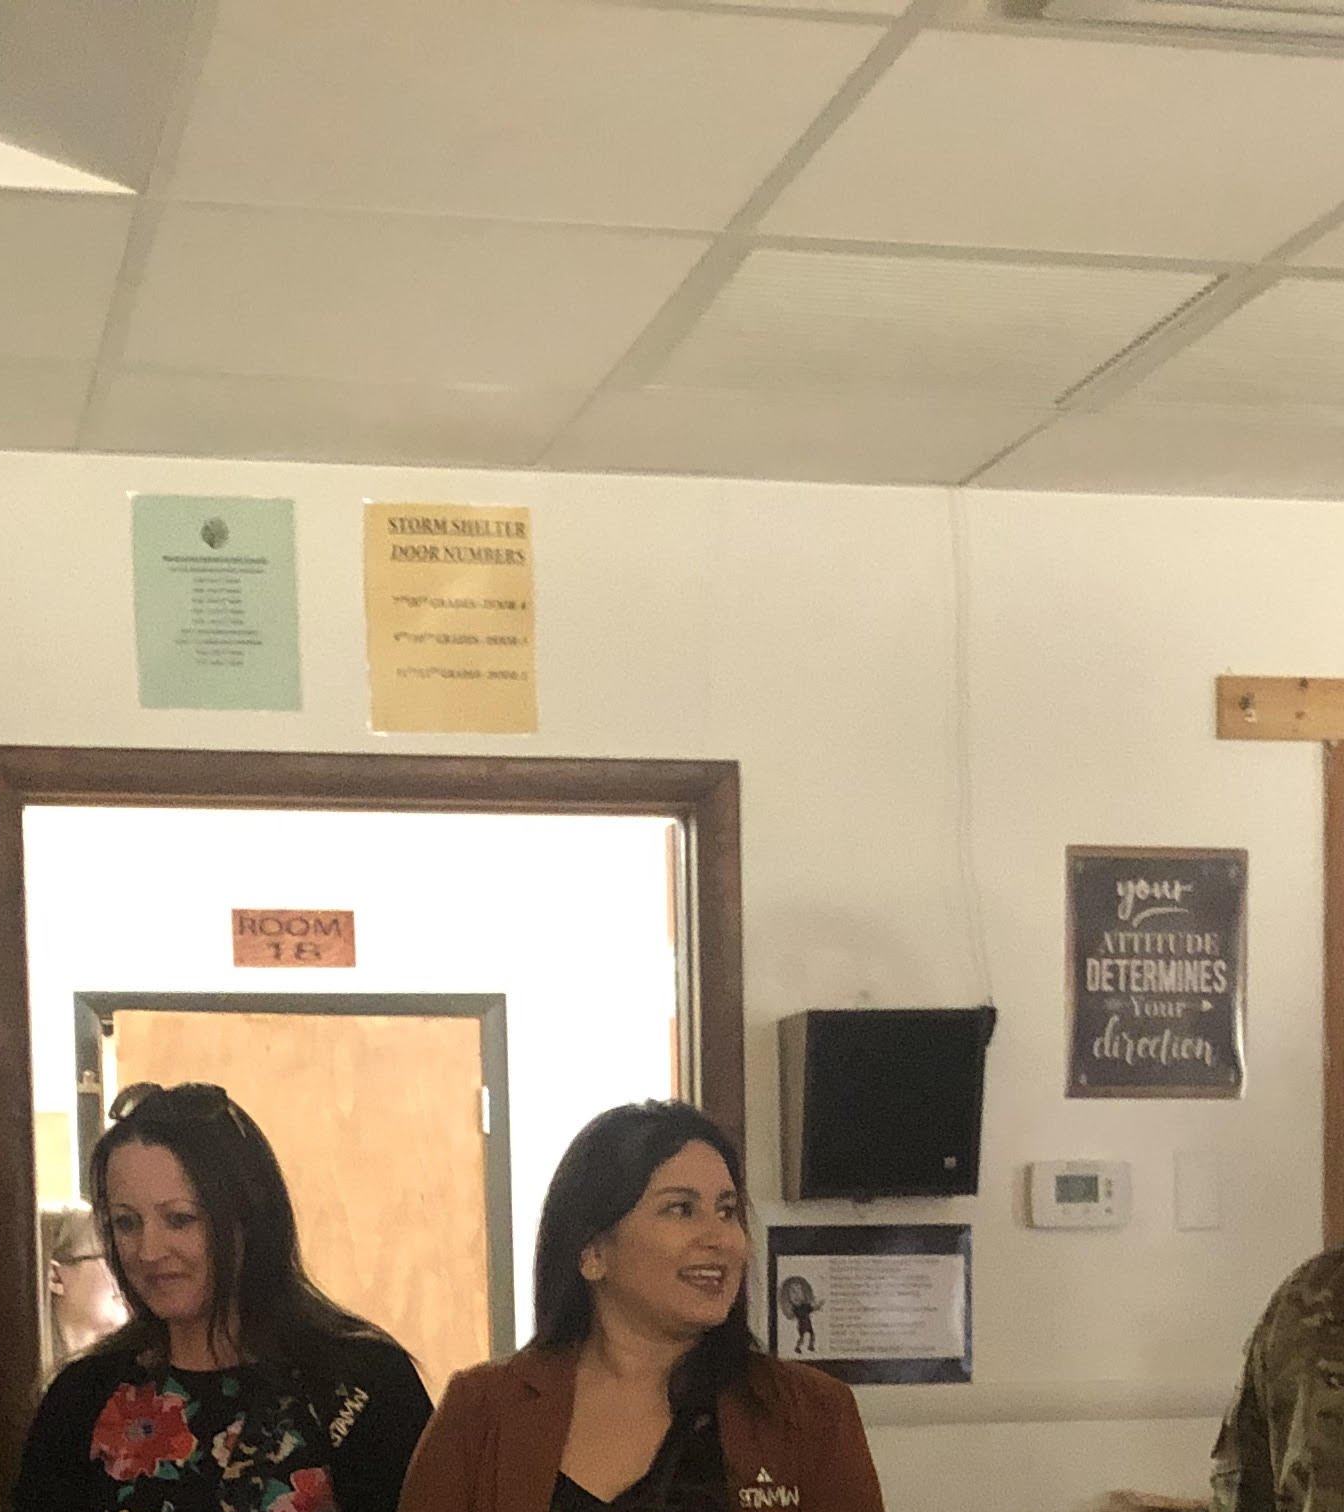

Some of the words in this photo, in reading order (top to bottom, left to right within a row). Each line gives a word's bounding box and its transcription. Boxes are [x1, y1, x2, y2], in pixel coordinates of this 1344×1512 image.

[388, 516, 448, 536] STORM
[451, 518, 527, 539] SHELTER
[391, 544, 440, 563] DOOR
[443, 546, 526, 566] NUMBERS
[1115, 878, 1194, 921] your
[237, 915, 342, 937] ROOM
[1099, 930, 1220, 954] ATTITUDE
[1085, 957, 1228, 994] DETERMINES
[1092, 1014, 1214, 1067] direction
